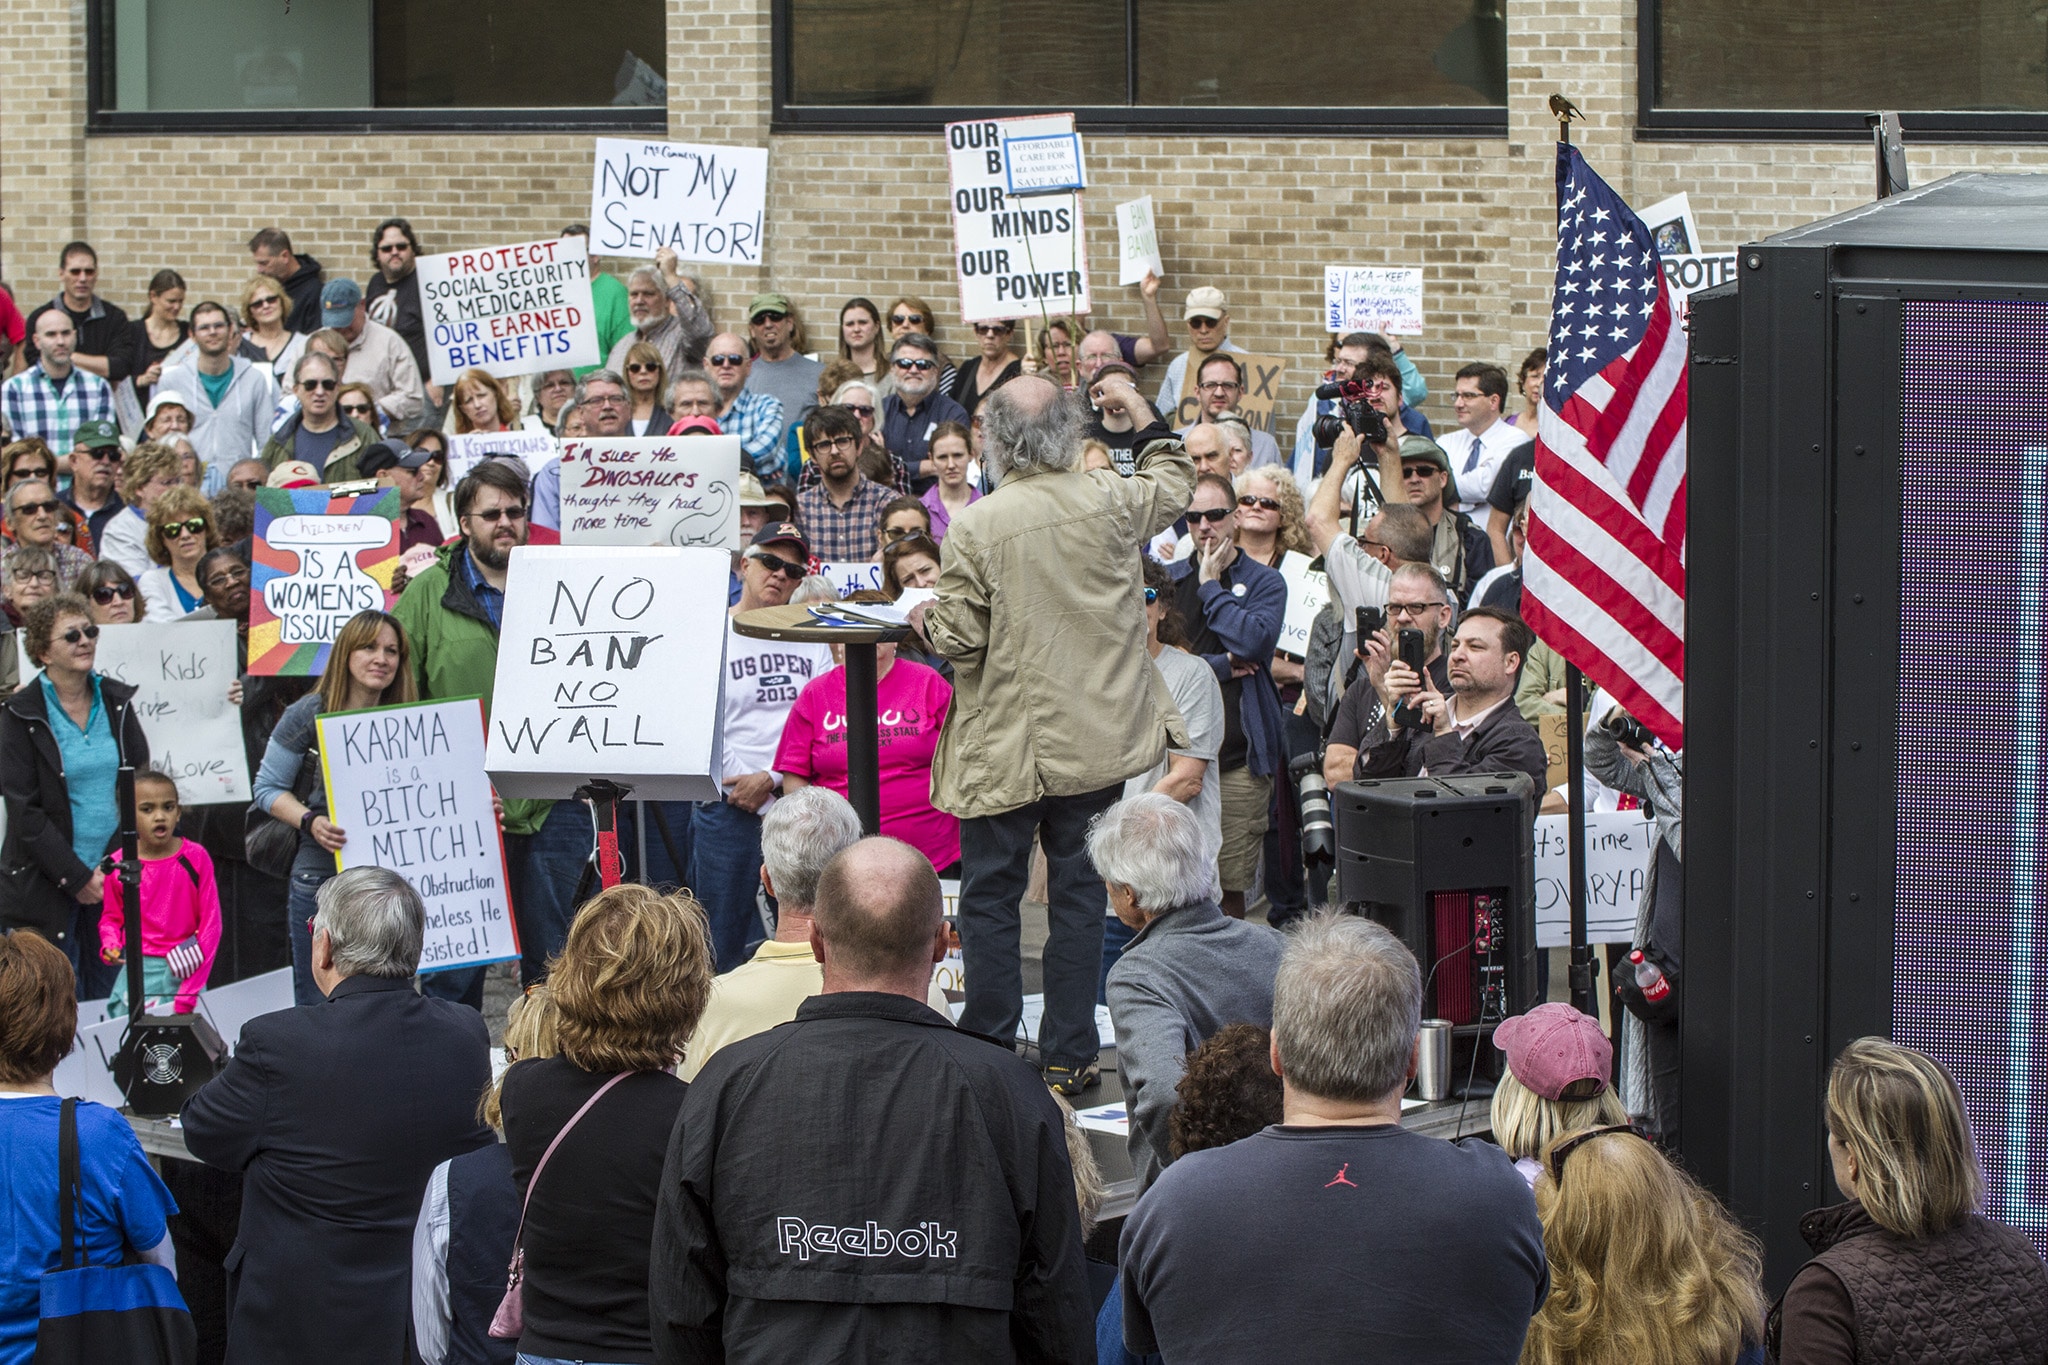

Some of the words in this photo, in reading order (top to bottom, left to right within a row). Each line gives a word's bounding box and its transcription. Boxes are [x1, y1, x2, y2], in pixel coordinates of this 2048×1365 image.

[950, 122, 999, 150] OUR
[1011, 140, 1072, 151] AFFORDABLE
[1020, 153, 1045, 162] CARE
[1047, 151, 1066, 160] FOR
[1030, 163, 1076, 173] AMERICANS
[602, 153, 670, 199] NOT
[1017, 177, 1043, 187] SAVE
[1048, 175, 1075, 185] ACA!
[956, 186, 1005, 214] OUR
[601, 201, 762, 261] SENATOR!
[991, 208, 1071, 238] MINDS
[448, 241, 559, 276] PROTECT
[961, 249, 1010, 276] OUR
[425, 276, 493, 300] SOCIAL
[496, 259, 586, 291] SECURITY
[996, 271, 1083, 301] POWER
[1385, 271, 1412, 282] KEEP
[433, 302, 449, 323] &
[458, 285, 565, 320] MEDICARE
[1329, 299, 1342, 328] HEAR
[1350, 297, 1407, 308] IMMIGRANTS
[434, 322, 480, 346] OUR
[490, 307, 582, 338] EARNED
[1347, 317, 1394, 330] EDUCATIN
[448, 330, 572, 368] BENEFITS
[580, 466, 699, 488] DINOSAURS
[563, 493, 620, 514] thought
[628, 492, 662, 514] they
[668, 493, 702, 510] had
[572, 516, 606, 531] more
[614, 513, 652, 529] time
[334, 550, 354, 580] A
[271, 582, 374, 610] WOMEN'S
[549, 575, 655, 627] NO
[160, 650, 207, 681] Kids
[530, 635, 664, 671] BAN
[730, 656, 756, 680] US
[759, 654, 813, 678] OPEN
[554, 681, 619, 702] NO
[756, 687, 798, 702] 2013
[343, 711, 450, 766] KARMA
[499, 715, 664, 755] WALL
[893, 727, 920, 738] STATE
[165, 750, 233, 780] Love
[386, 767, 401, 784] is
[411, 765, 422, 781] a
[362, 780, 457, 826] BITCH
[420, 868, 495, 898] Obstruction
[480, 898, 502, 923] He
[422, 926, 491, 963] sisted!
[777, 1216, 958, 1260] Reebok
